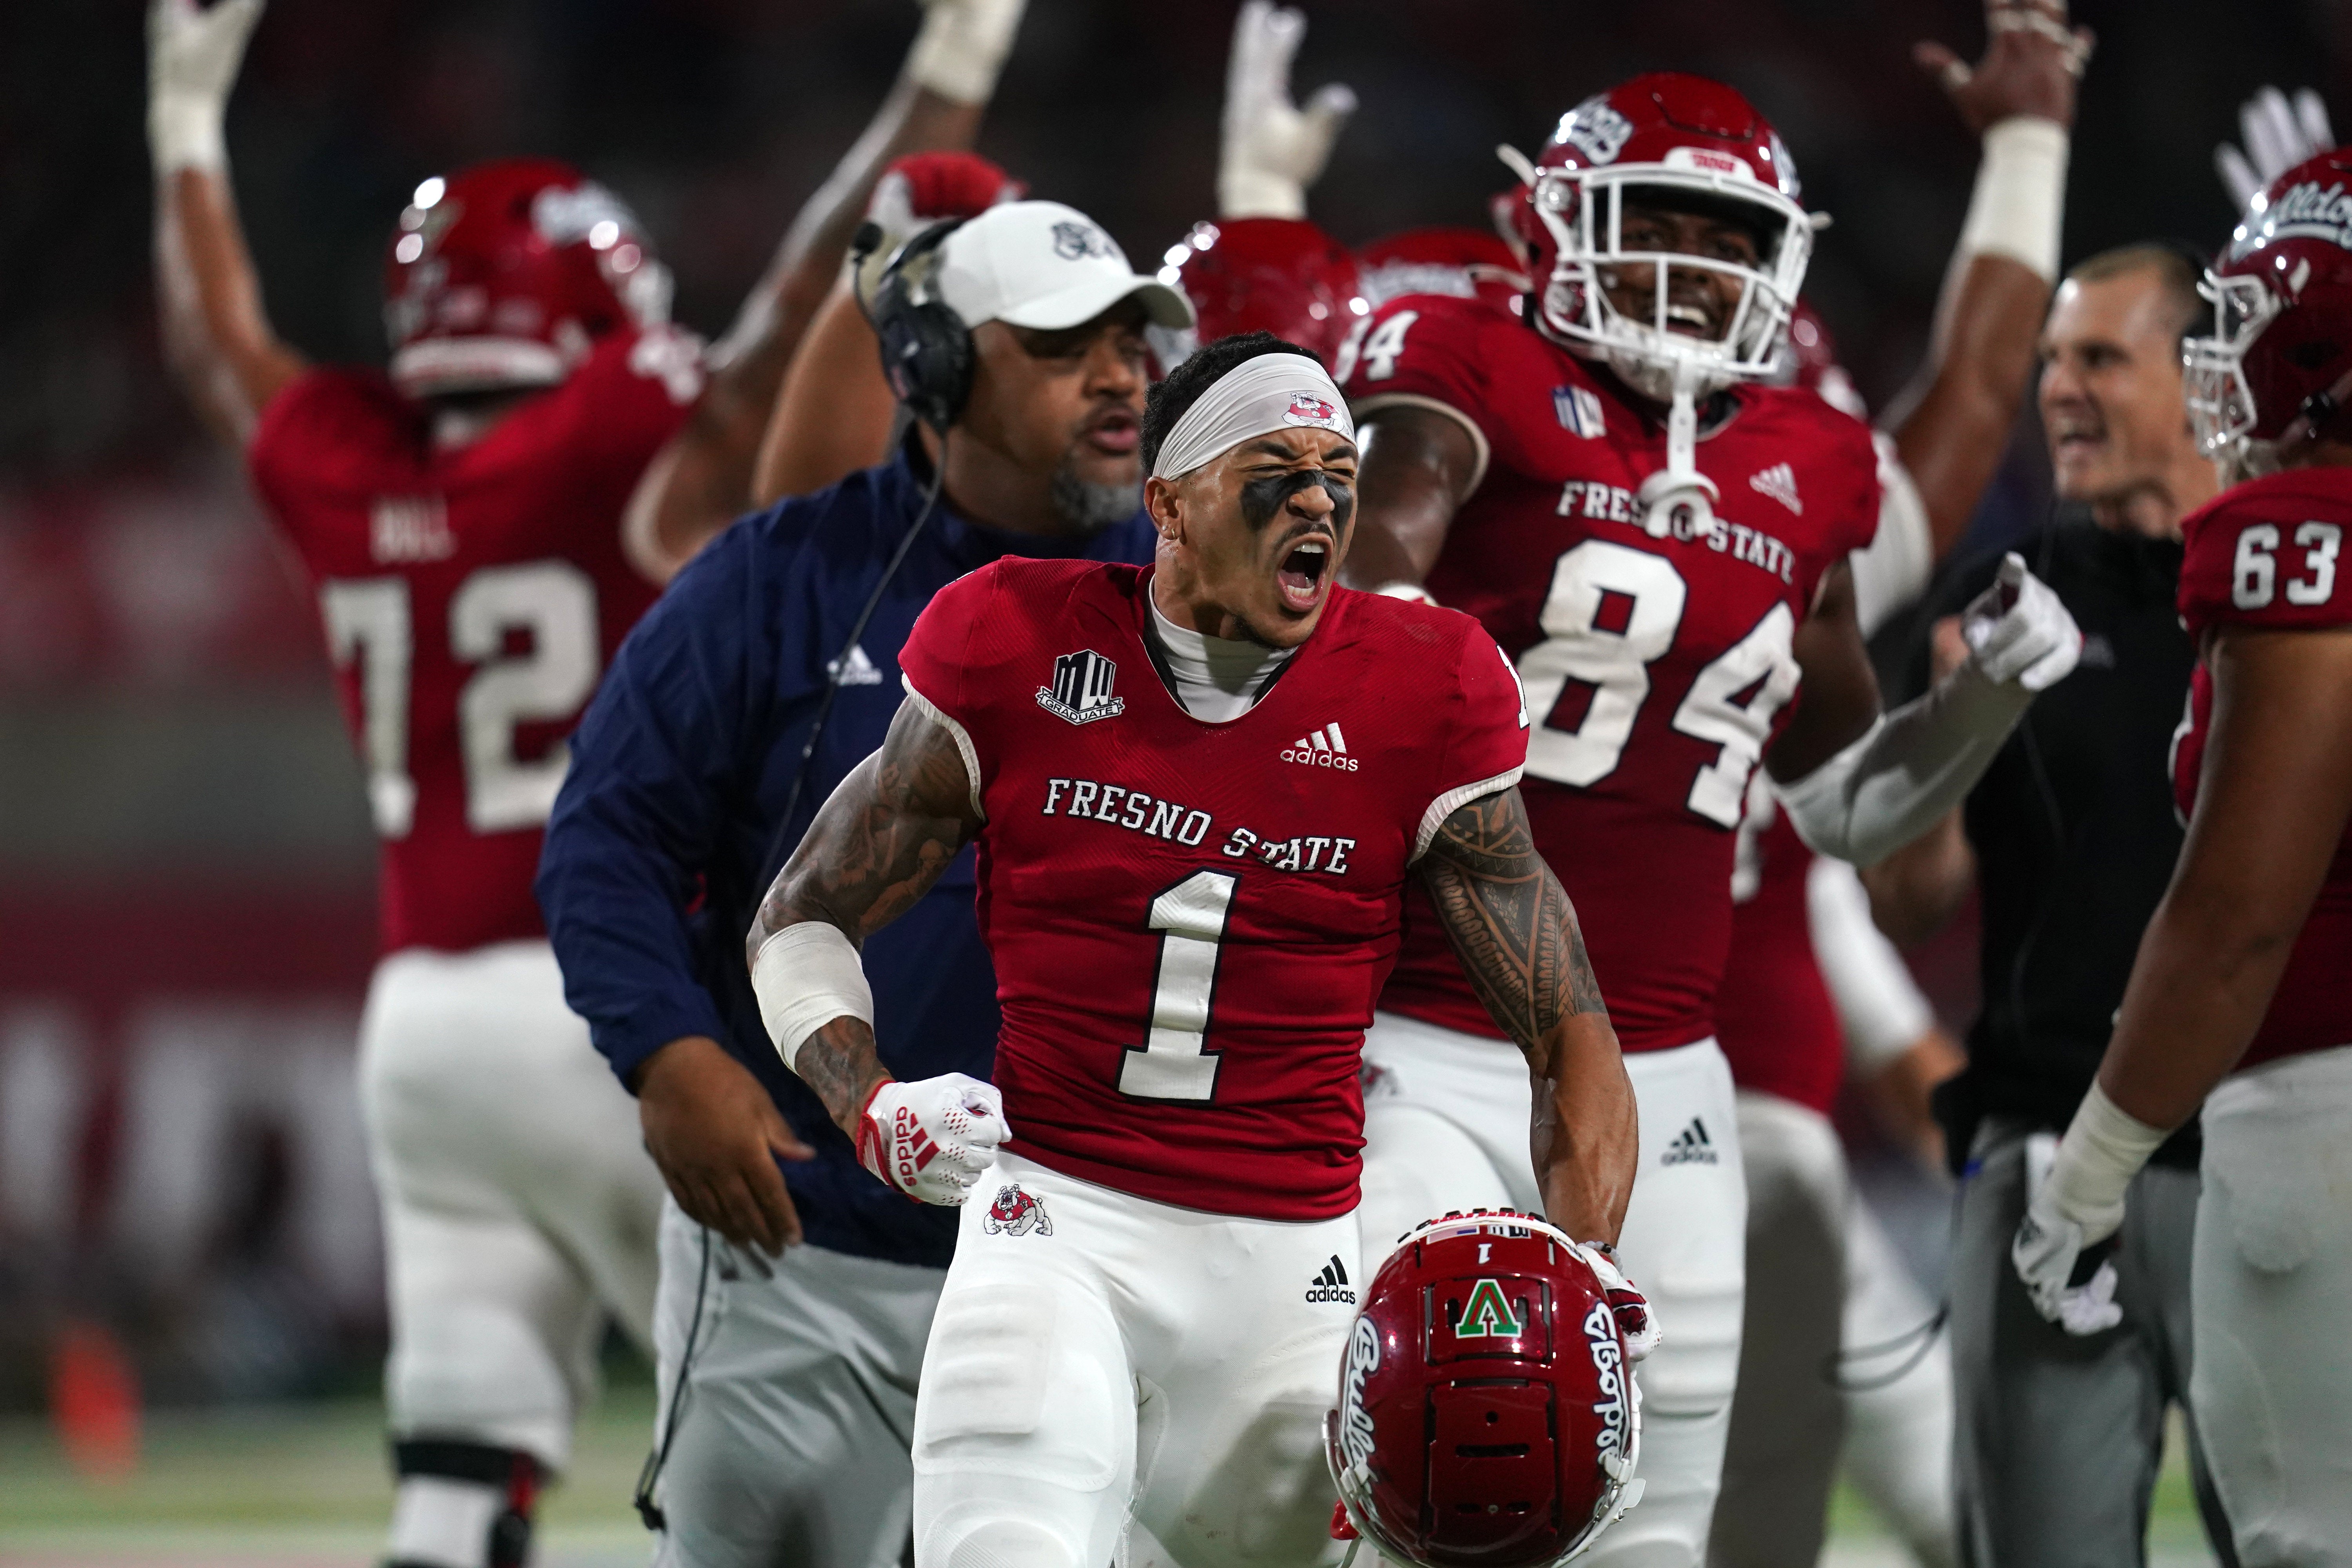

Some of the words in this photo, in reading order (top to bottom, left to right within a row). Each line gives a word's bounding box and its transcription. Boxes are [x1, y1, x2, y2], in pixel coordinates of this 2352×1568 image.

[2232, 521, 2342, 610] 63
[319, 561, 598, 837] 72
[1045, 699, 1114, 721] GRADUATE
[1518, 539, 1802, 830] 84
[1280, 747, 1358, 772] adidas
[1042, 778, 1212, 846] FRESNO
[1222, 827, 1356, 875] STATE
[1118, 869, 1237, 1102] 1
[896, 1106, 918, 1187] adidas
[1305, 1285, 1356, 1305] adidas
[1478, 1243, 1492, 1265] 1
